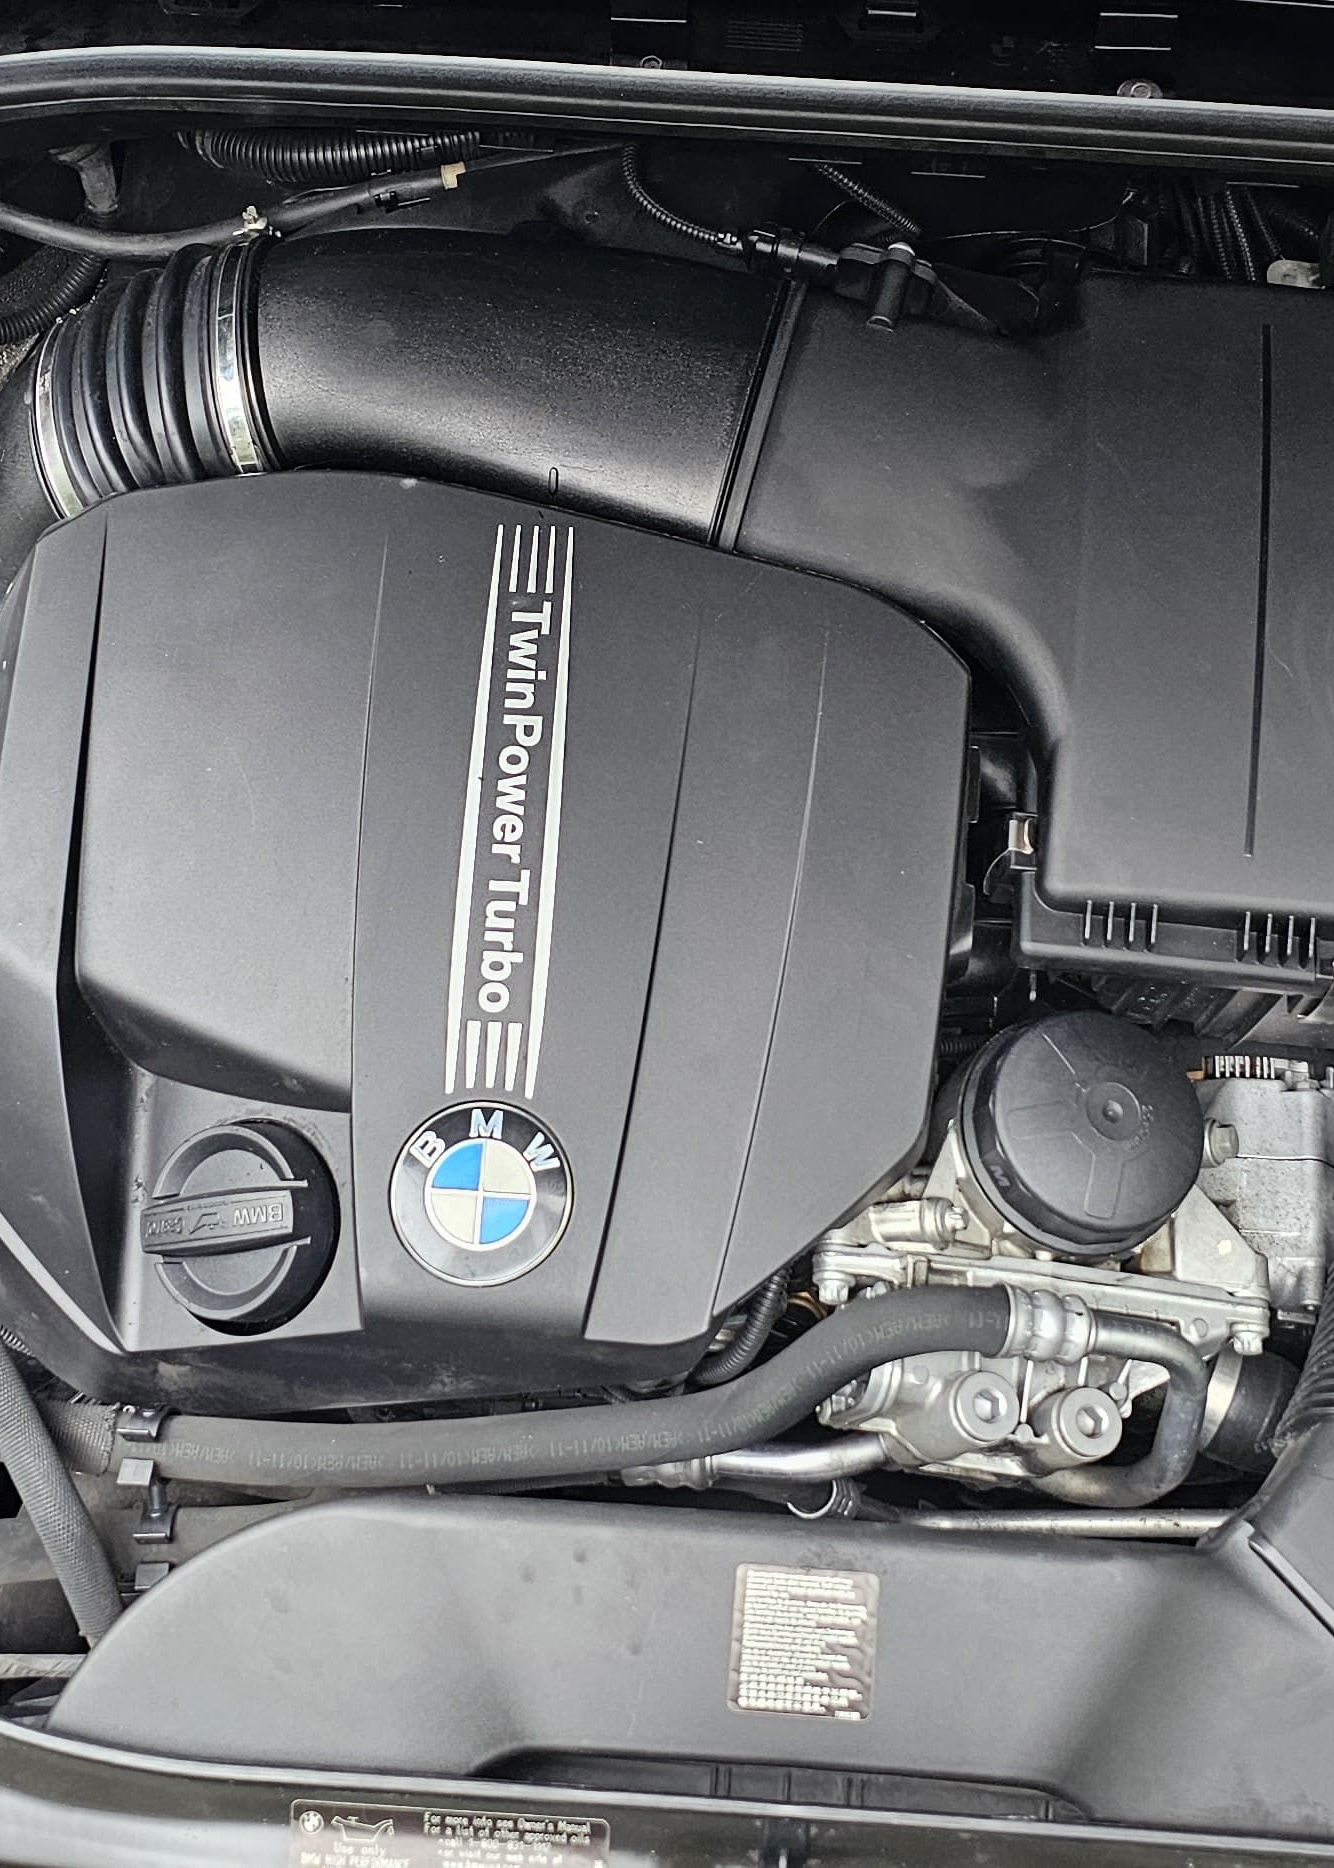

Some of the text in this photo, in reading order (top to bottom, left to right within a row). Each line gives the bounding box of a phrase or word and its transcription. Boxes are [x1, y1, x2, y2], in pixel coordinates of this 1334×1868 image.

[476, 601, 552, 1013] TwinPower Turbo
[408, 1108, 561, 1173] BMW
[232, 1202, 284, 1228] BMW
[424, 1811, 441, 1824] For
[445, 1814, 468, 1826] more
[472, 1814, 493, 1828] info
[557, 1819, 591, 1834] Manual
[424, 1823, 590, 1846] For a list of other approved oils
[333, 1841, 387, 1856] Use only
